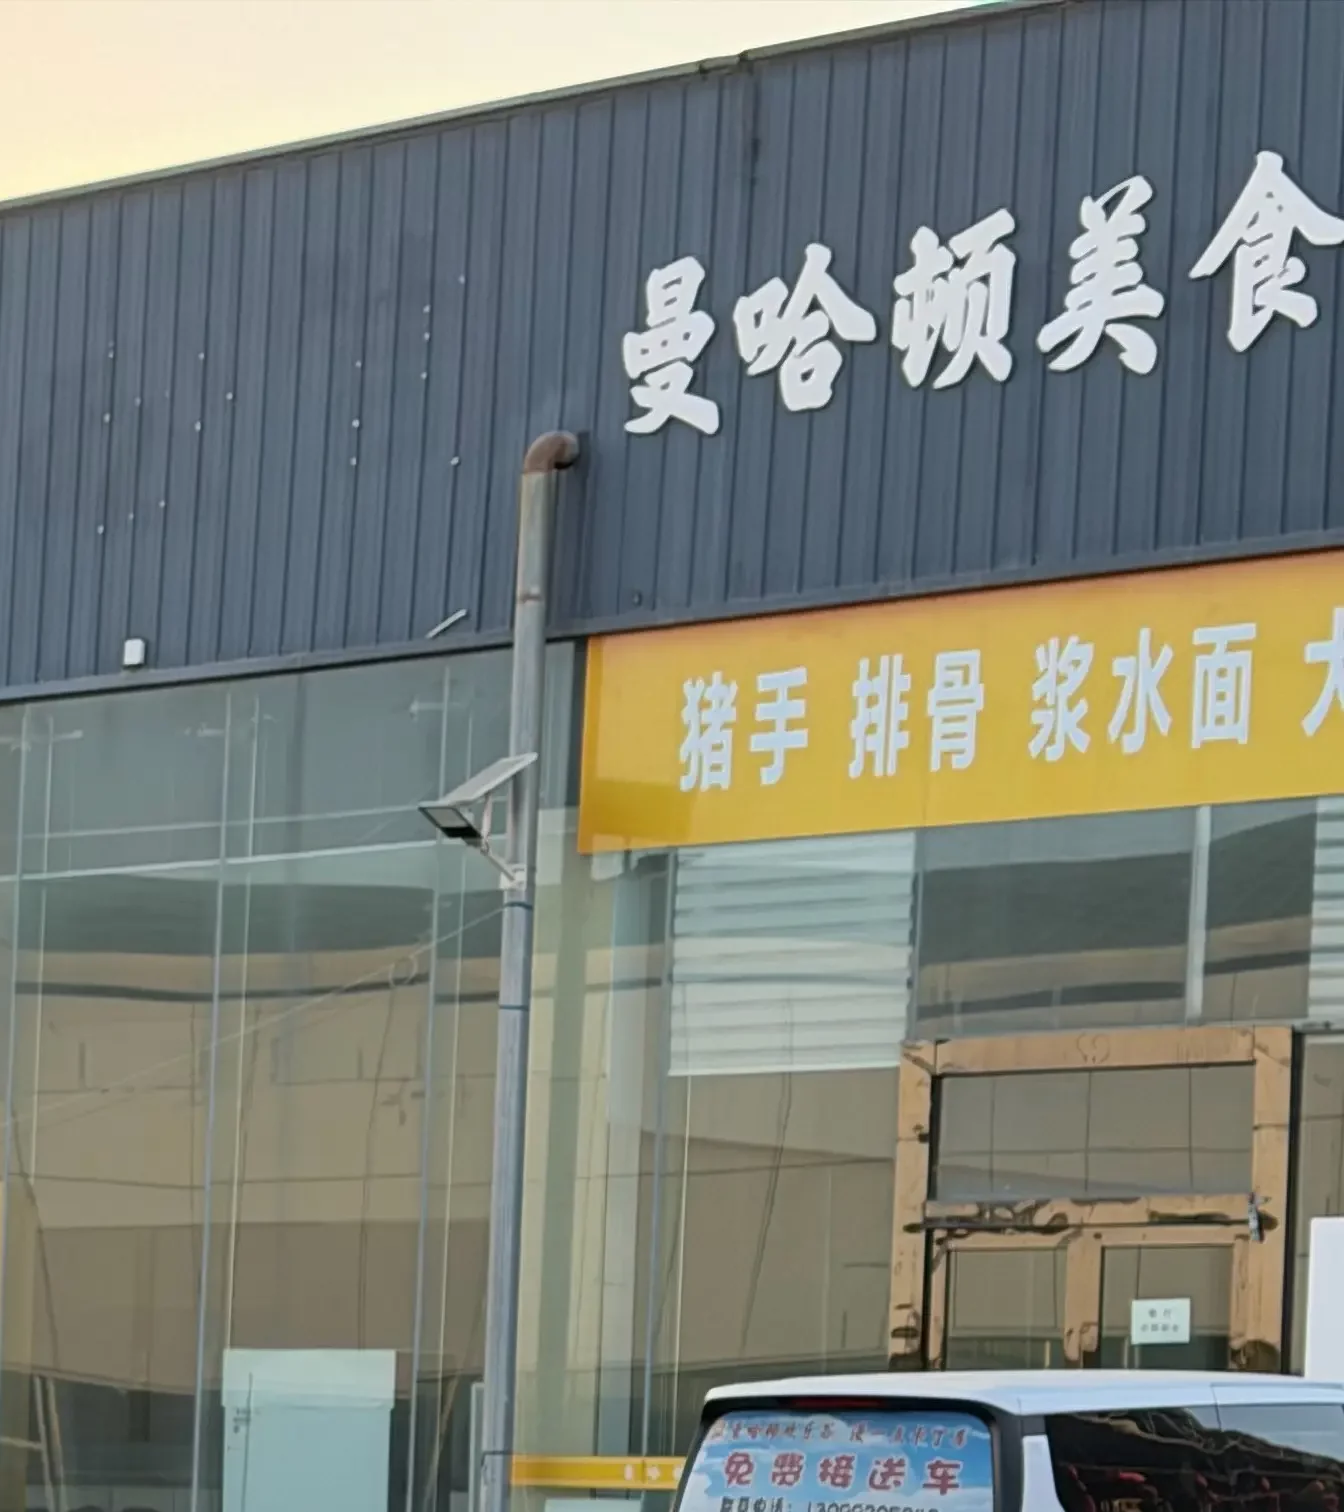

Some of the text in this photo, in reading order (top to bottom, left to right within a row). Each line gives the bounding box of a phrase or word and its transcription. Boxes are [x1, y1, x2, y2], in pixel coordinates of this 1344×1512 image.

[621, 150, 1344, 435] 曼哈顿美食
[679, 666, 809, 793] 猪手
[849, 648, 985, 780] 排骨
[1028, 622, 1258, 763] 浆水面
[723, 1450, 963, 1496] 免费接送车
